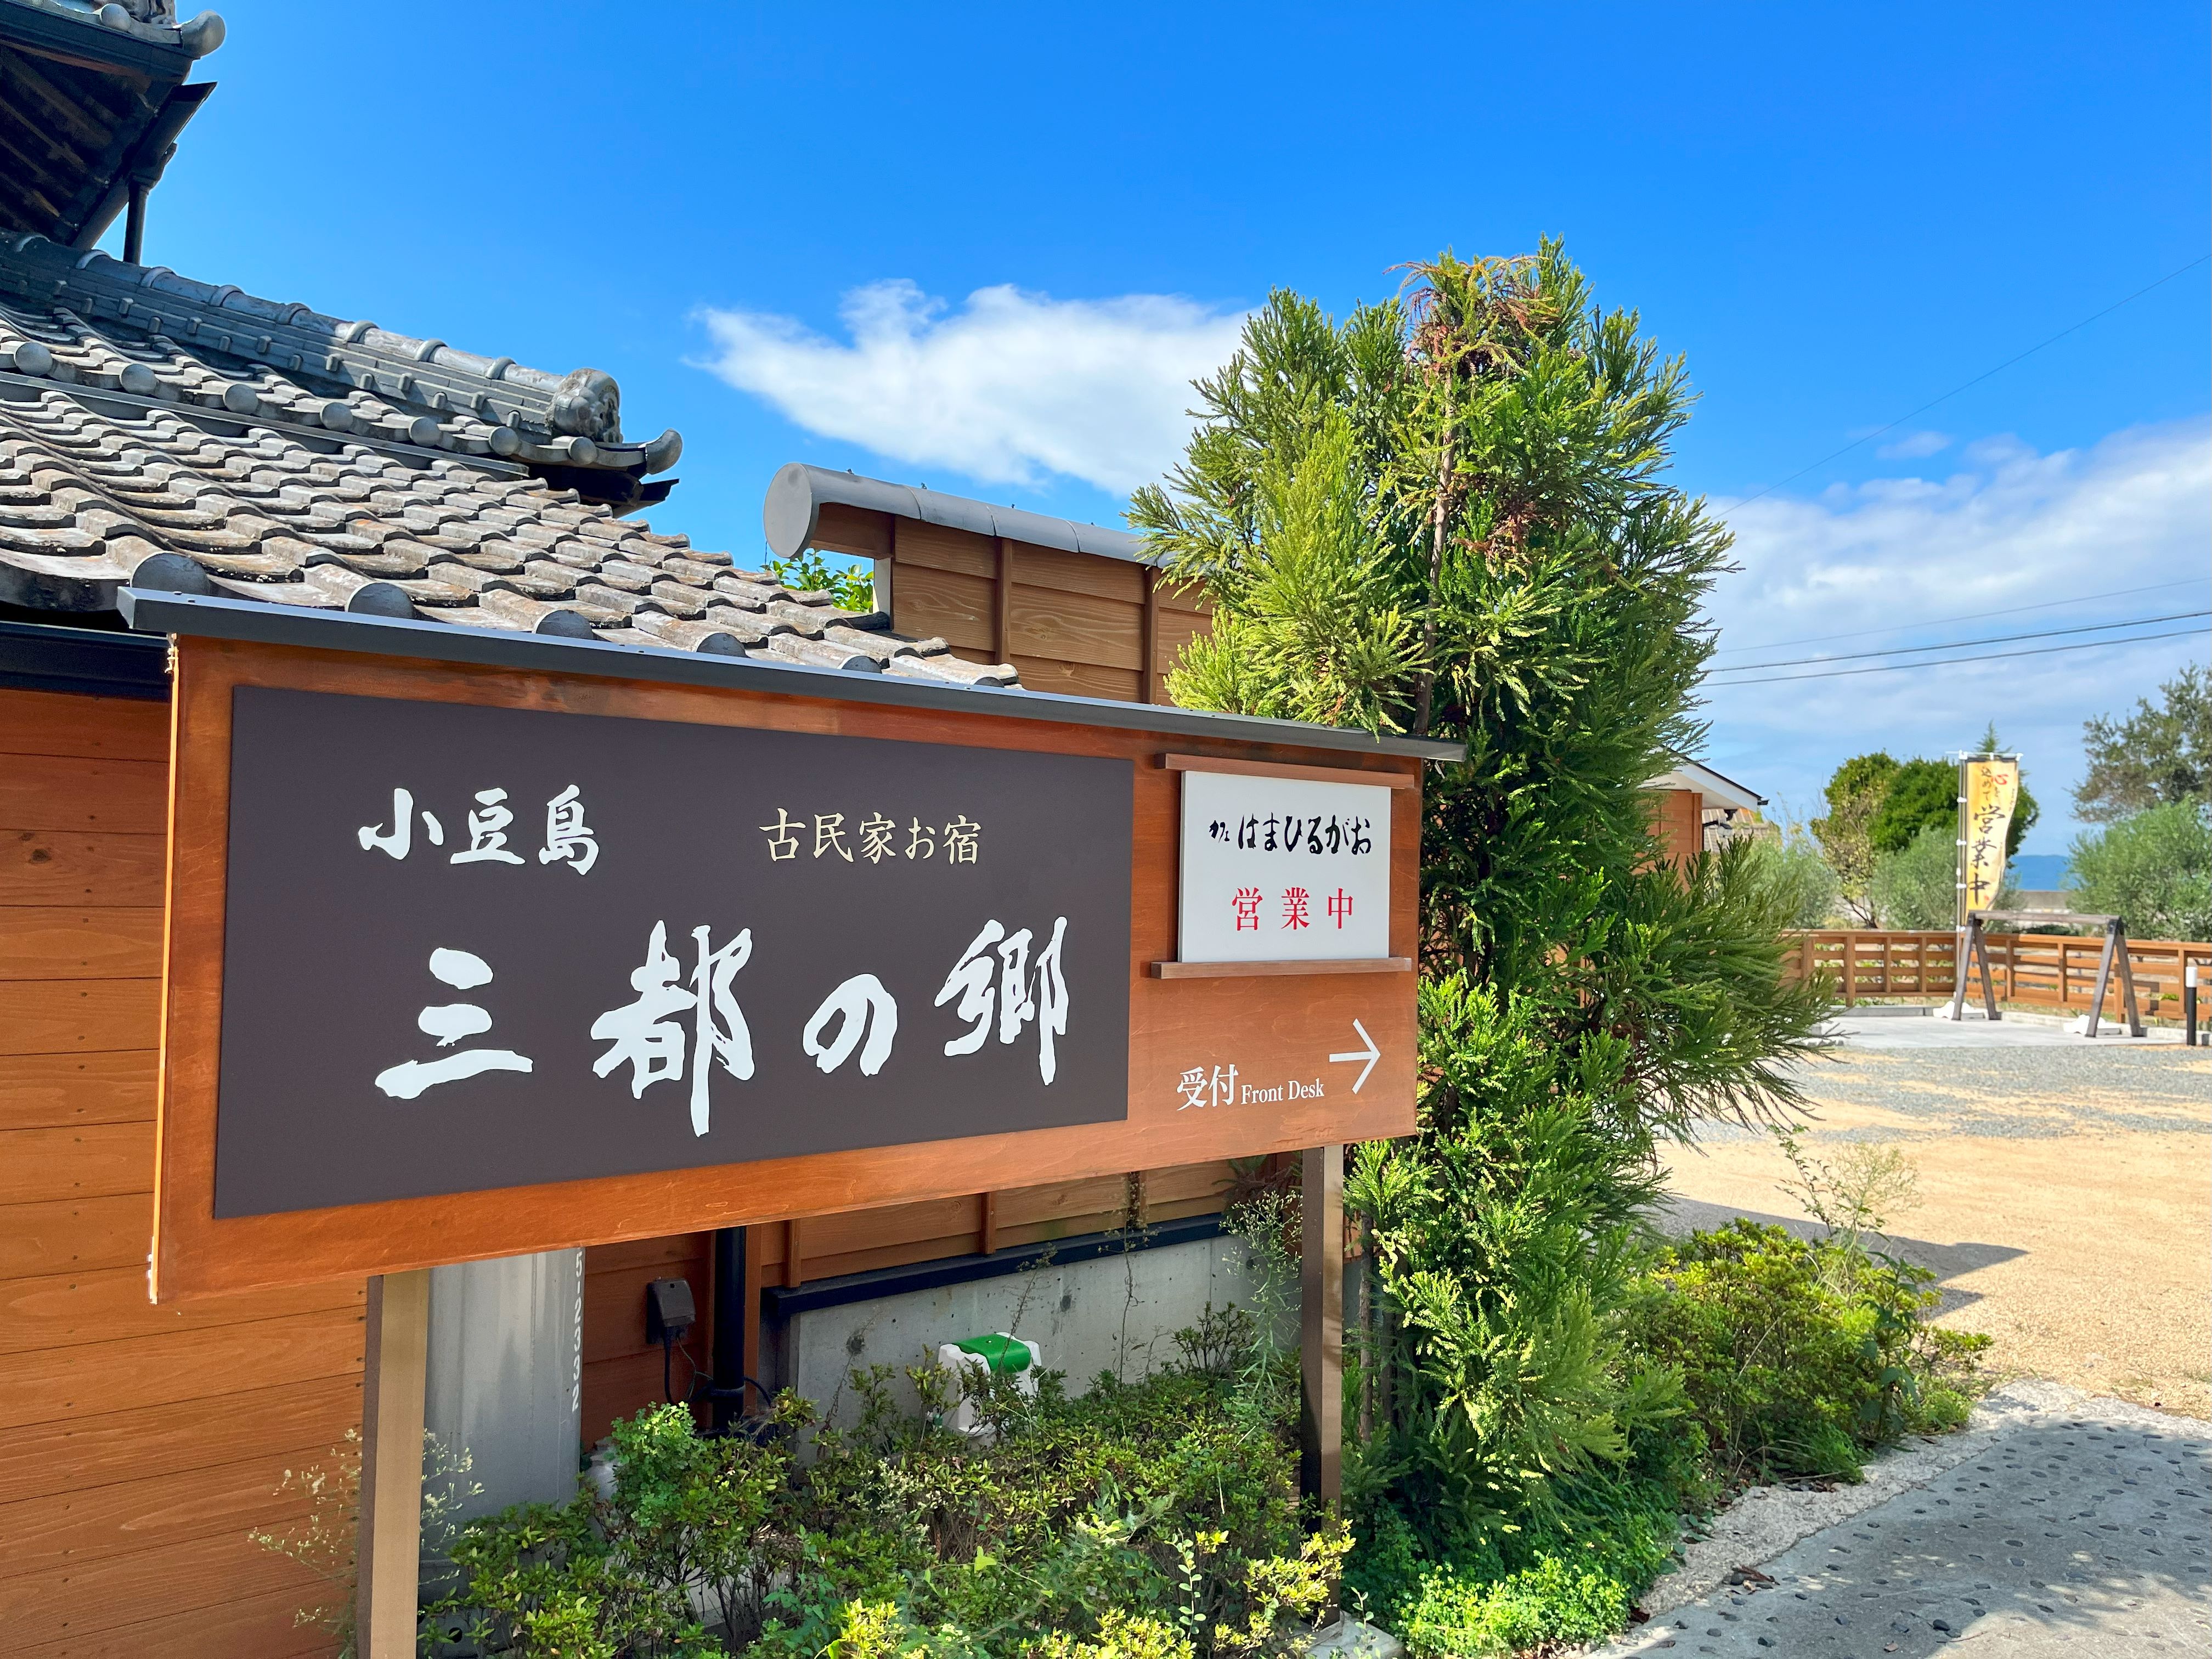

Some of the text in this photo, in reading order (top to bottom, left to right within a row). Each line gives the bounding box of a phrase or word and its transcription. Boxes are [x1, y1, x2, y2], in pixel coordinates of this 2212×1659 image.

[358, 784, 599, 876] 小豆島
[759, 808, 981, 865] 古民家お宿
[1232, 887, 1353, 931] 営業中
[374, 916, 1070, 1138] 三都の郷
[1176, 1064, 1325, 1111] 受付 Front Desk
